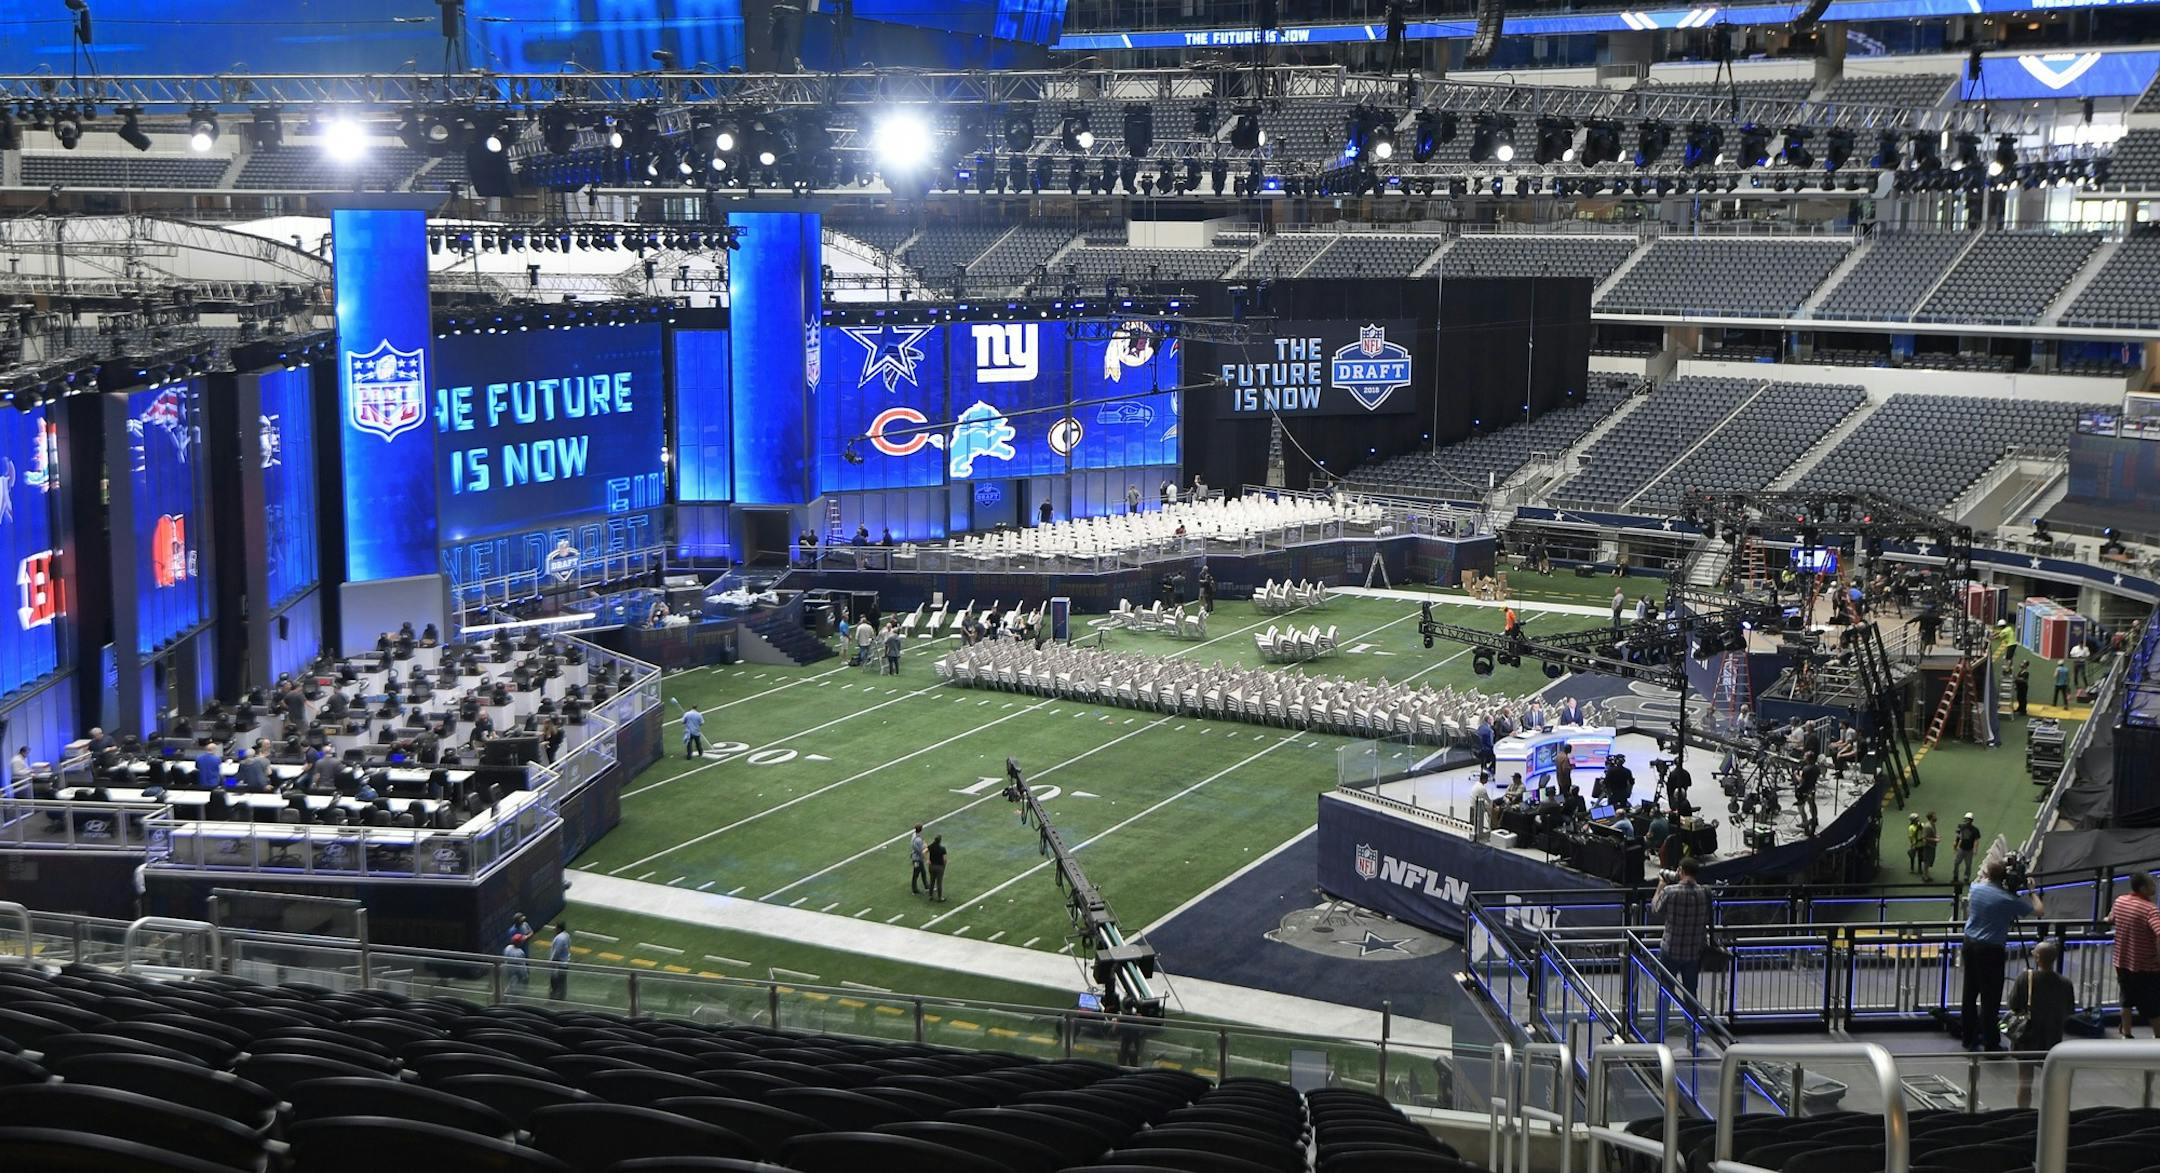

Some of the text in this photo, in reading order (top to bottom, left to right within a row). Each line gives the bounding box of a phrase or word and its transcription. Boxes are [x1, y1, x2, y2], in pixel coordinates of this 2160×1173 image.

[1185, 33, 1208, 45] THE
[1213, 30, 1261, 44] FUTURE
[1275, 338, 1322, 361] THE
[1363, 339, 1380, 352] NFL
[1222, 362, 1322, 387] FUTURE
[1338, 364, 1404, 379] DRAFT
[435, 372, 633, 432] HE FUTURE
[1235, 386, 1321, 411] IS NOW
[452, 435, 589, 495] IS NOW
[551, 558, 579, 570] DRAFT
[1358, 857, 1375, 874] NFL
[1380, 855, 1469, 905] NFLN
